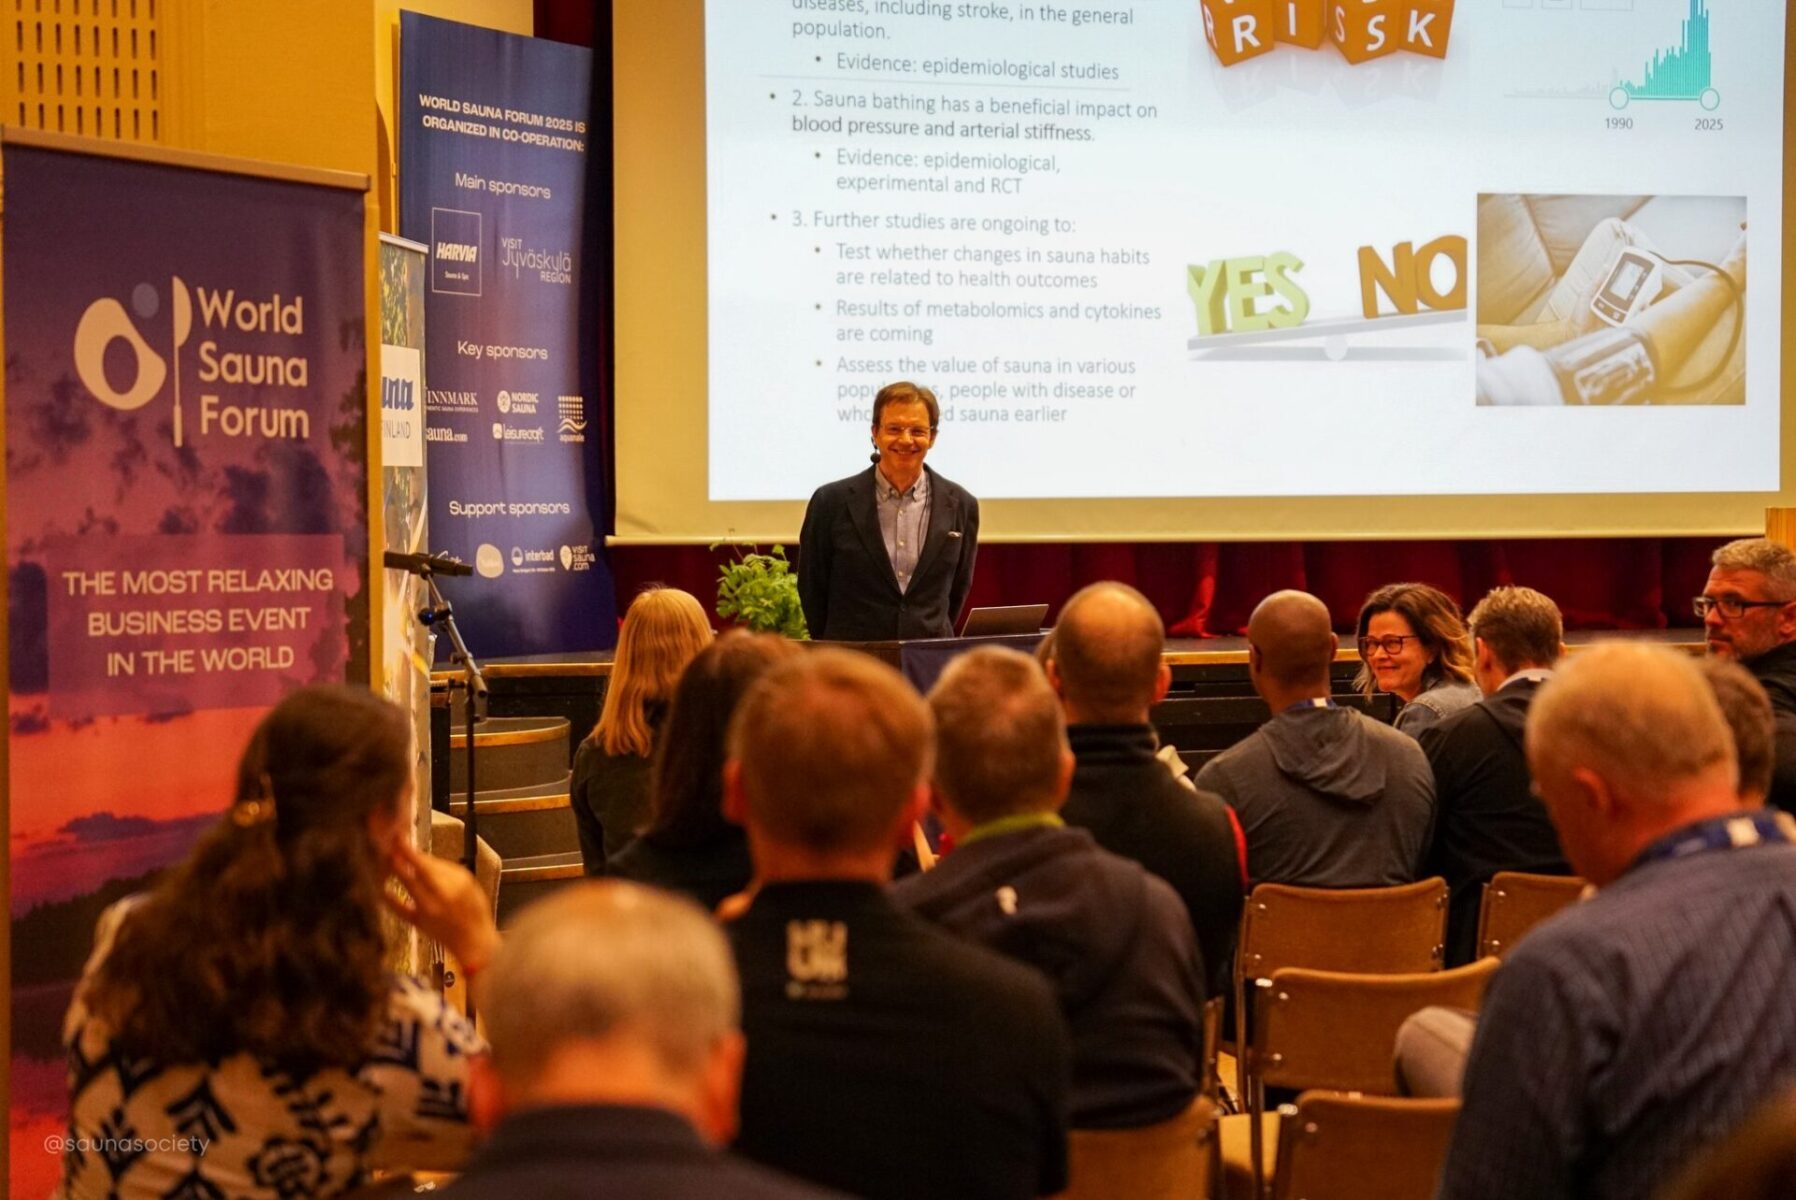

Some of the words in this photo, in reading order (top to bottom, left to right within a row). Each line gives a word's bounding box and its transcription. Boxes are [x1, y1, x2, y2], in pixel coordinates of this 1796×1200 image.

[875, 0, 952, 21] including
[957, 3, 1014, 22] stroke,
[1019, 4, 1034, 20] in
[1040, 5, 1067, 22] the
[1072, 8, 1134, 26] general
[792, 20, 891, 39] population.
[837, 52, 917, 72] Evidence:
[923, 57, 1055, 80] epidemiological
[1060, 62, 1120, 80] studies
[419, 94, 460, 112] WORLD
[463, 102, 502, 120] SAUNA
[505, 109, 543, 126] FORUM
[545, 117, 573, 132] 2025
[575, 121, 586, 133] IS
[792, 89, 808, 107] 2.
[814, 90, 866, 109] Sauna
[873, 93, 936, 114] bathing
[941, 95, 970, 113] has
[975, 101, 984, 113] a
[990, 97, 1070, 116] beneficial
[1076, 100, 1131, 120] impact
[1137, 105, 1157, 118] on
[422, 115, 487, 137] ORGANIZED
[489, 127, 500, 139] IN
[502, 129, 584, 152] CO-OPERATION:
[792, 115, 842, 132] blood
[848, 120, 919, 136] pressure
[924, 121, 955, 137] and
[960, 123, 1019, 139] arterial
[1024, 123, 1095, 141] stiffness.
[1605, 117, 1633, 129] 1990
[1694, 118, 1724, 130] 2025
[837, 148, 918, 167] Evidence:
[923, 152, 1061, 175] epidemiological,
[455, 172, 486, 191] Main
[489, 180, 551, 199] sponsors
[836, 174, 949, 193] experimental
[954, 177, 985, 193] and
[991, 177, 1022, 194] RCT
[792, 210, 808, 227] 3.
[814, 211, 879, 227] Further
[886, 213, 945, 229] studies
[950, 217, 976, 230] are
[981, 216, 1049, 236] ongoing
[1055, 218, 1076, 233] to:
[436, 242, 477, 262] HARVIA
[502, 238, 522, 249] VISIT
[836, 242, 871, 260] Test
[876, 243, 948, 261] whether
[953, 245, 1021, 266] changes
[1027, 247, 1041, 262] in
[1047, 251, 1095, 264] sauna
[1100, 248, 1151, 265] habits
[502, 246, 571, 279] Jyväskylä
[540, 271, 571, 284] REGION
[836, 271, 864, 284] are
[871, 269, 931, 285] related
[937, 272, 954, 286] to
[959, 270, 1011, 287] health
[1016, 273, 1098, 288] outcomes
[1357, 235, 1468, 319] NO
[1187, 251, 1311, 335] YES
[197, 286, 303, 335] World
[837, 300, 898, 317] Results
[904, 300, 922, 317] of
[927, 301, 1044, 318] metabolomics
[1050, 303, 1079, 319] and
[1085, 303, 1162, 322] cytokines
[836, 328, 864, 341] are
[870, 326, 933, 345] coming
[457, 341, 484, 360] Key
[487, 345, 548, 360] sponsors
[198, 341, 308, 387] Sauna
[837, 356, 893, 373] Assess
[899, 357, 927, 373] the
[932, 357, 977, 373] value
[982, 356, 999, 374] of
[1004, 361, 1052, 374] sauna
[1058, 357, 1072, 374] in
[1077, 358, 1136, 374] various
[382, 376, 414, 411] una
[427, 390, 478, 406] INNMARK
[950, 382, 1007, 401] people
[1012, 382, 1048, 398] with
[1053, 382, 1114, 398] disease
[1119, 385, 1136, 398] or
[201, 395, 309, 439] Forum
[960, 409, 1009, 422] sauna
[1014, 405, 1067, 422] earlier
[383, 419, 411, 439] INLAND
[449, 500, 506, 518] Support
[509, 502, 570, 518] sponsors
[62, 570, 116, 597] THE
[122, 570, 202, 595] MOST
[207, 568, 333, 593] RELAXING
[88, 609, 222, 637] BUSINESS
[229, 607, 311, 631] EVENT
[107, 652, 134, 676] IN
[142, 649, 195, 674] THE
[201, 646, 294, 671] WORLD
